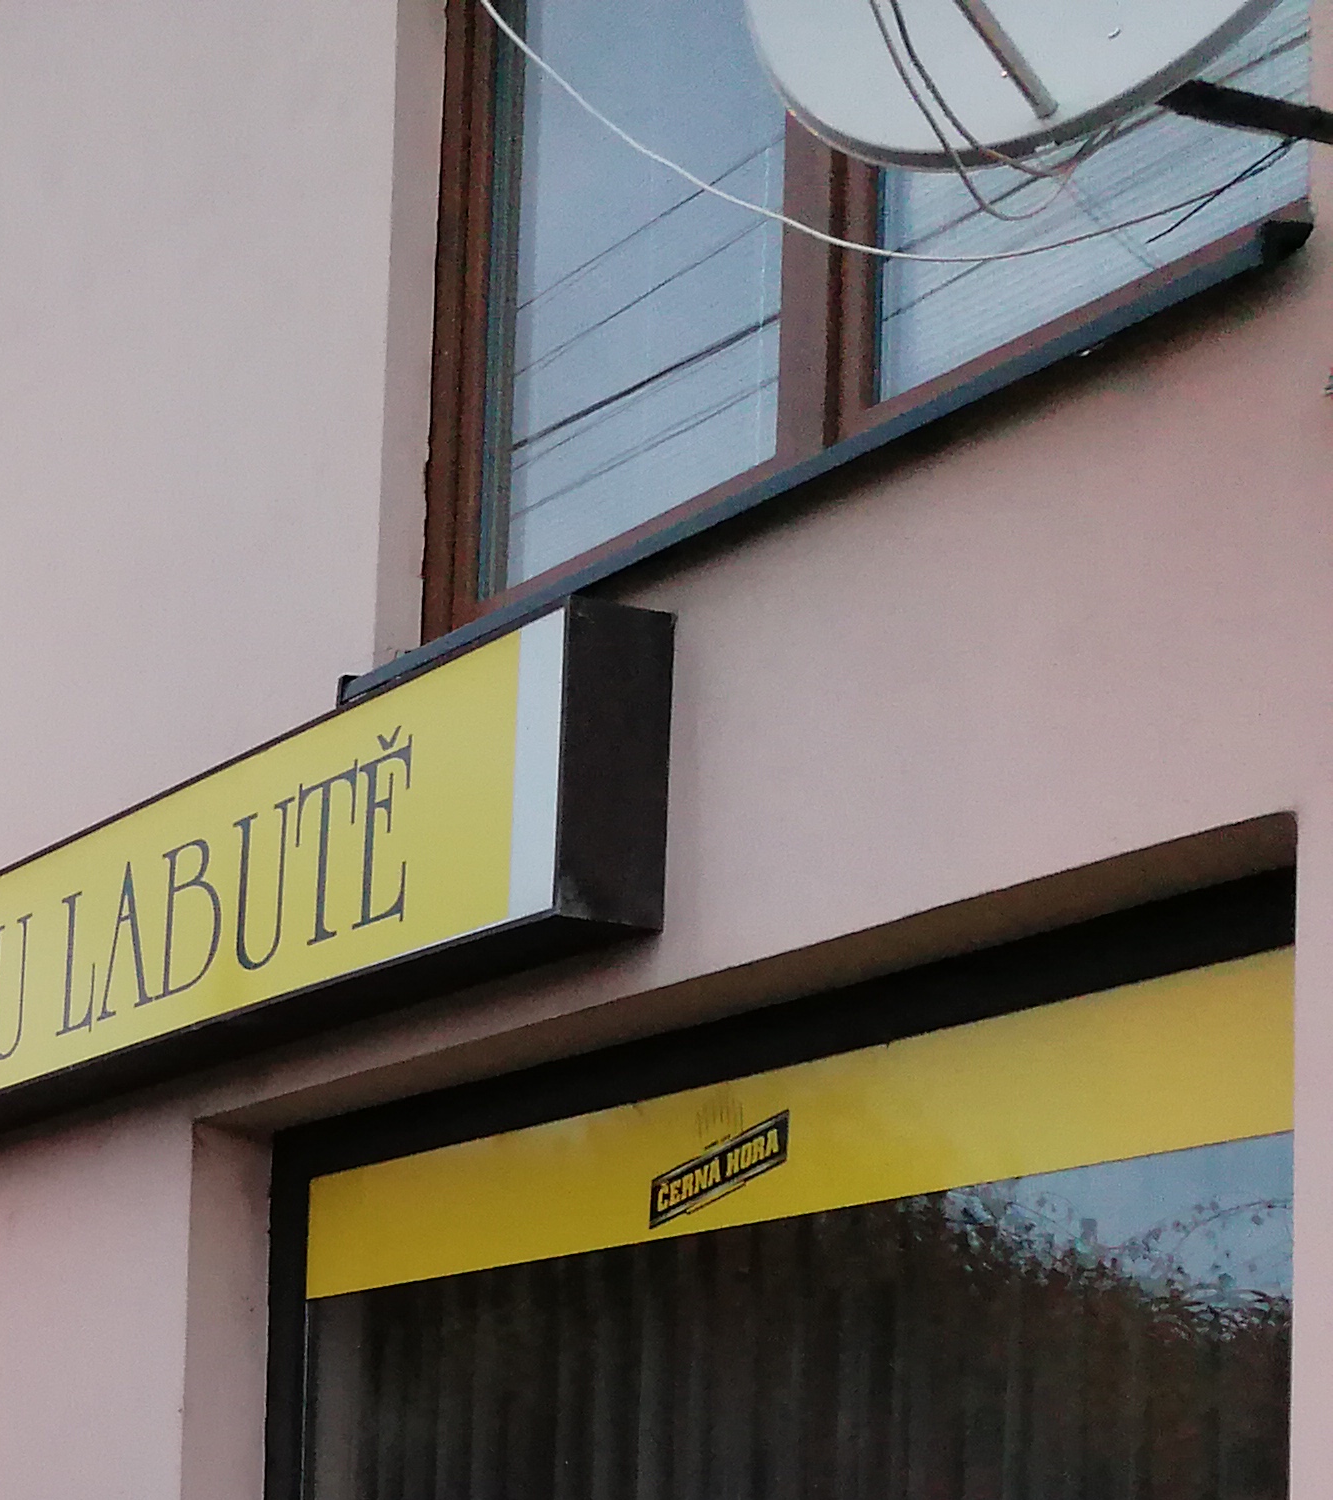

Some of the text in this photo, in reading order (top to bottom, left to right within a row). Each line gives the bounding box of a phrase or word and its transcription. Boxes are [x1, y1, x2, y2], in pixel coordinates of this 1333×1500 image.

[56, 725, 414, 1039] LABUTĚ
[657, 1128, 779, 1213] ČERNÁ HORA
